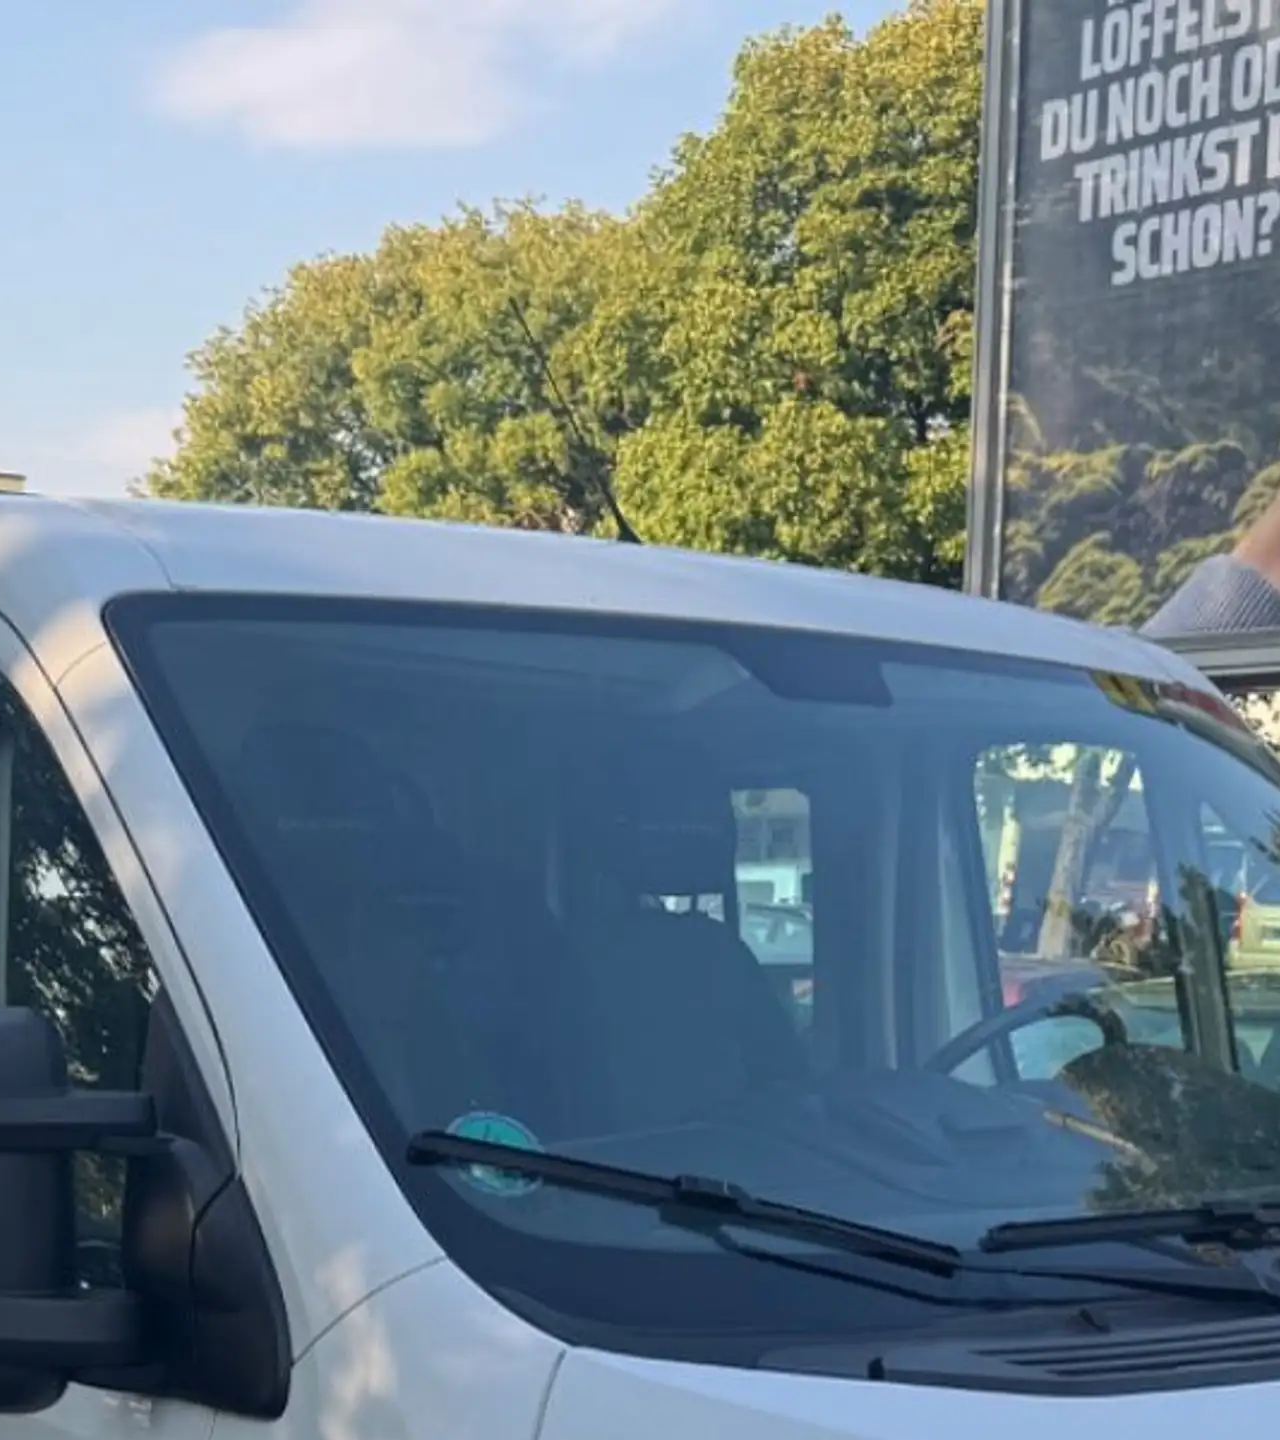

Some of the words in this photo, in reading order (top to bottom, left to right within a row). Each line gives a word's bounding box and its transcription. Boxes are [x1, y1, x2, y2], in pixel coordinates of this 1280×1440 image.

[1041, 89, 1098, 162] DU
[1106, 55, 1222, 145] NOCH
[1074, 120, 1260, 222] TRINKST
